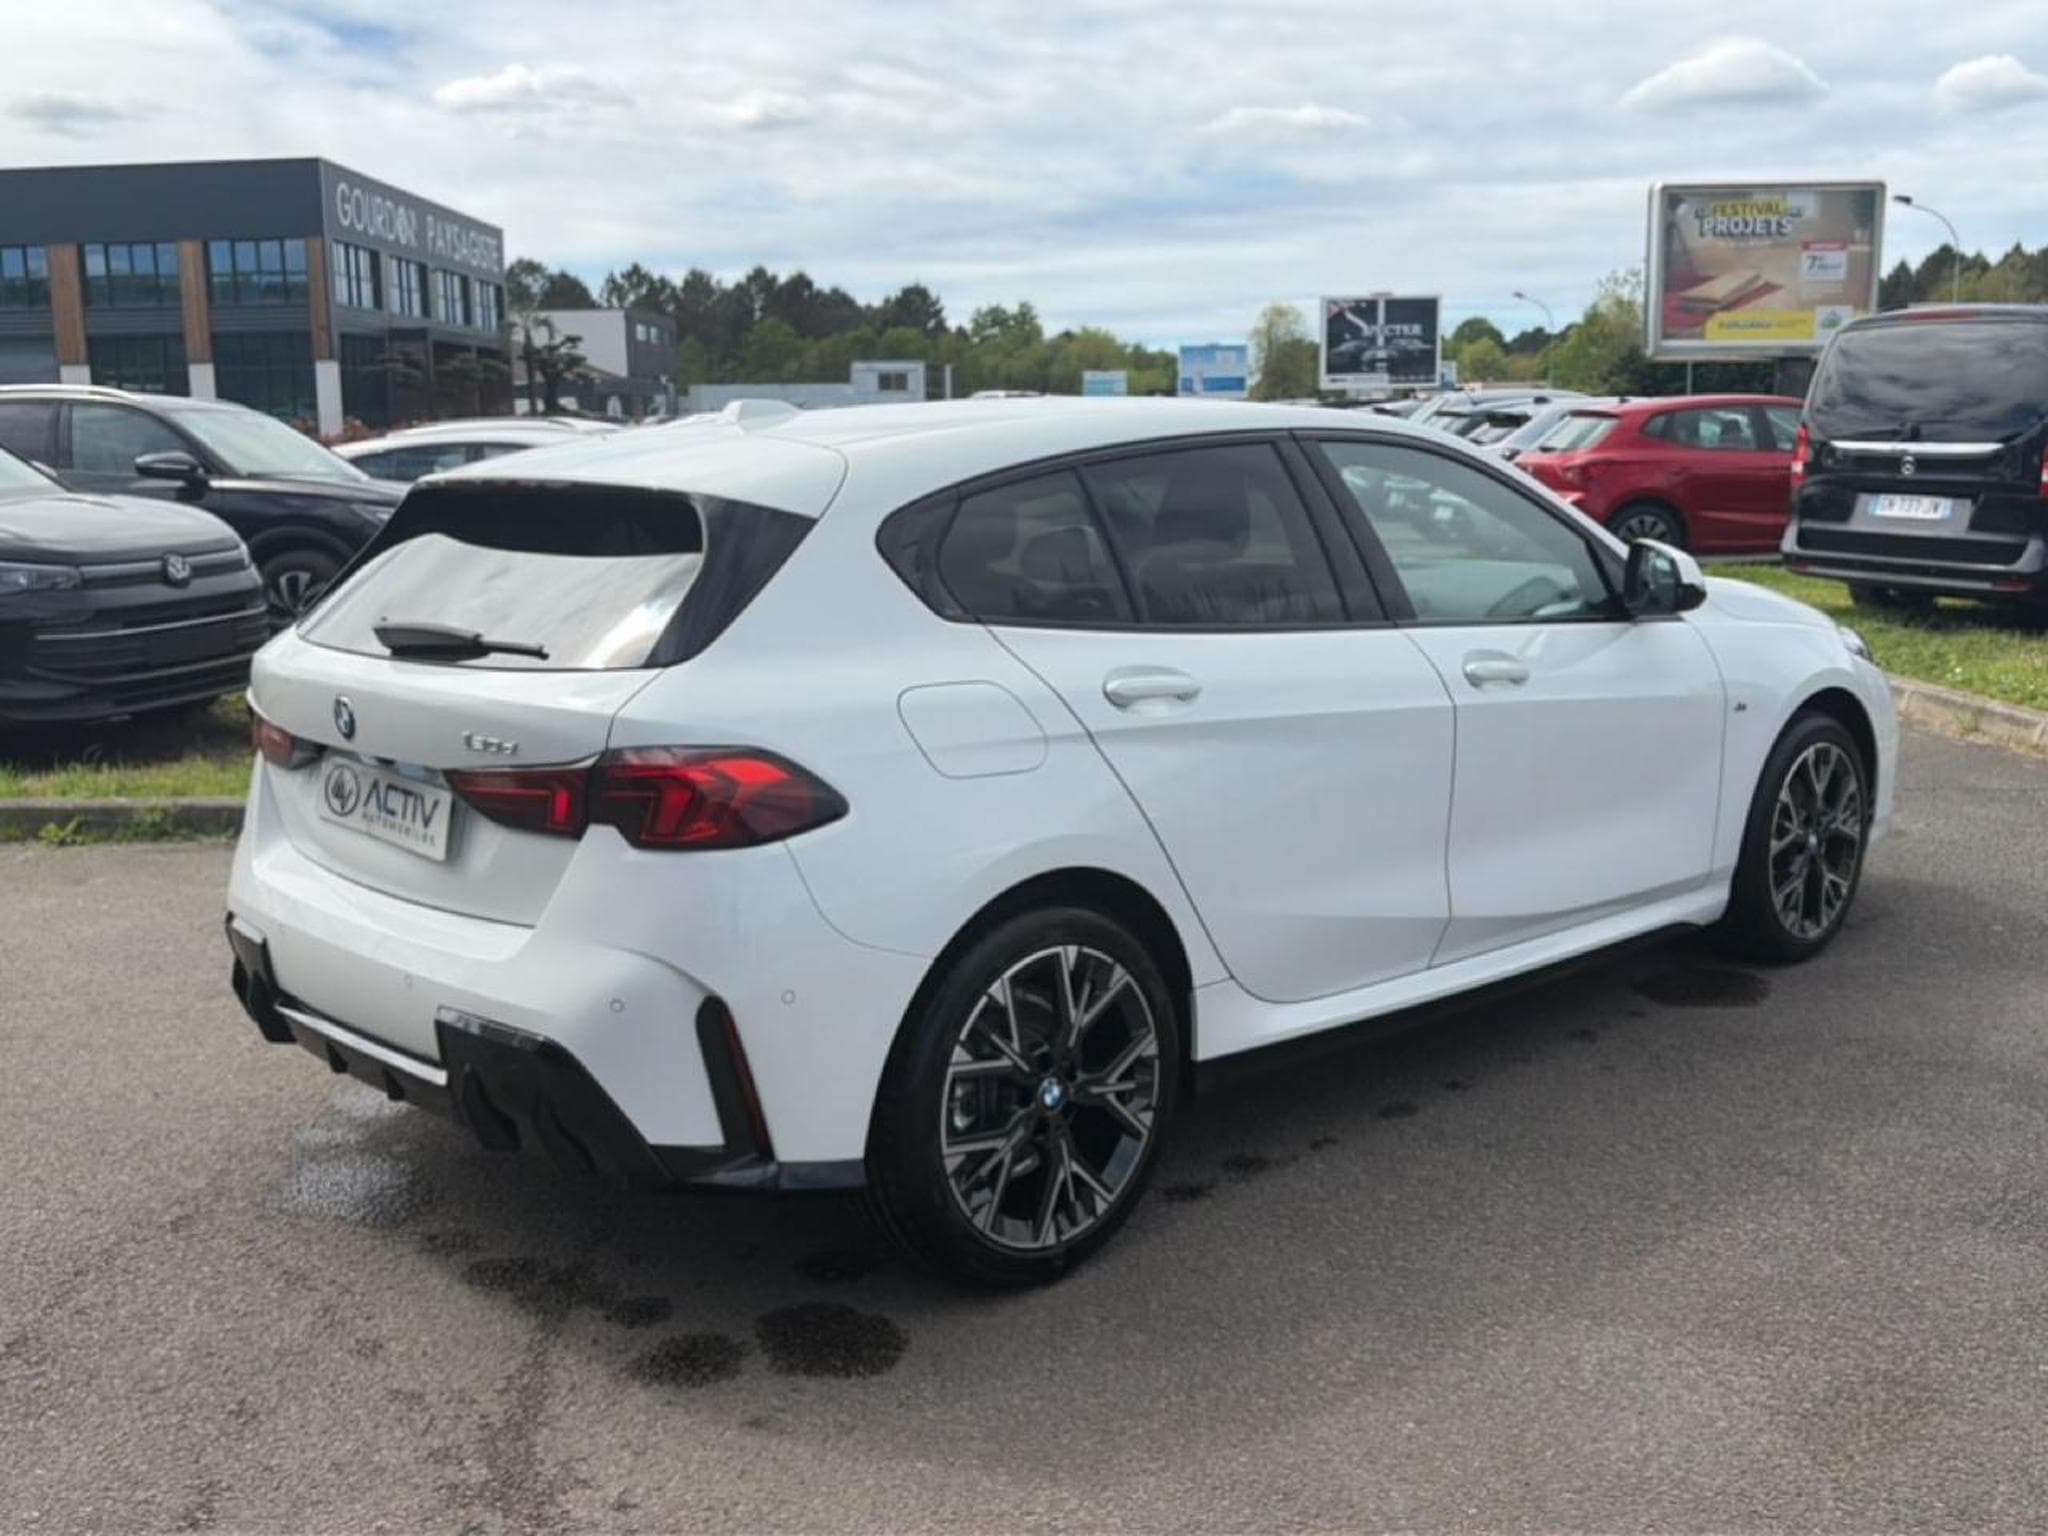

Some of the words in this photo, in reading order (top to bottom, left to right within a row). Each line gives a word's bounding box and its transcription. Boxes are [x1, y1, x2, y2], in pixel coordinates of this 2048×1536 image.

[336, 182, 418, 248] GOURDON
[1700, 217, 1793, 237] PROJETS
[1712, 202, 1785, 217] FESTIVAL
[363, 778, 440, 829] ACTIV
